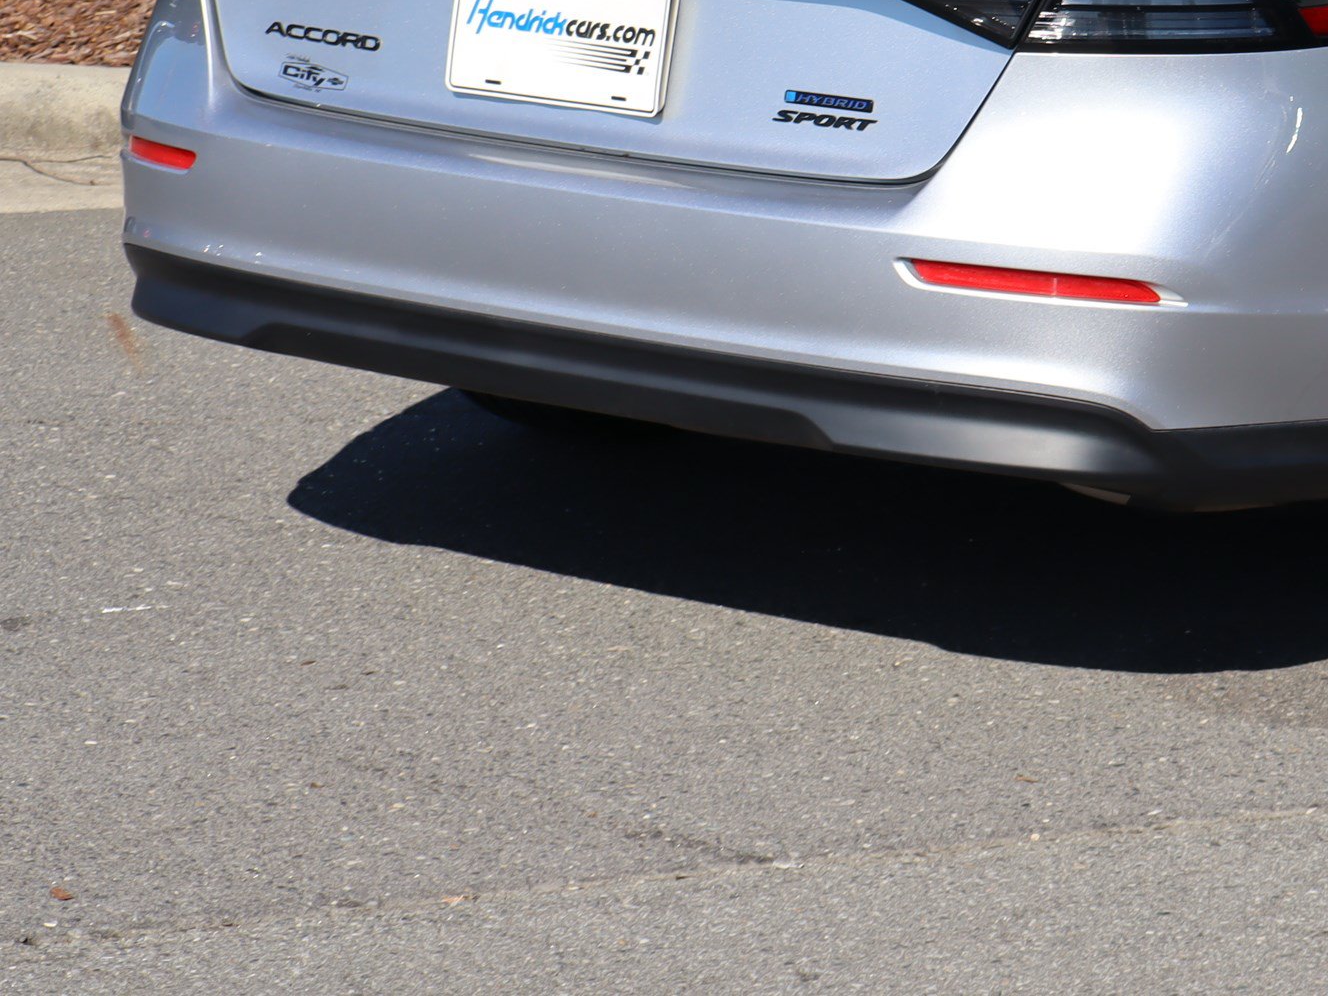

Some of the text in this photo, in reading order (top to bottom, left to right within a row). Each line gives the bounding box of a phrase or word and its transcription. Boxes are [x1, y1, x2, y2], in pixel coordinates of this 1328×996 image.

[265, 21, 381, 52] ACCORD
[282, 64, 325, 87] City
[796, 94, 868, 110] HYBRID
[772, 109, 878, 132] SPORT
